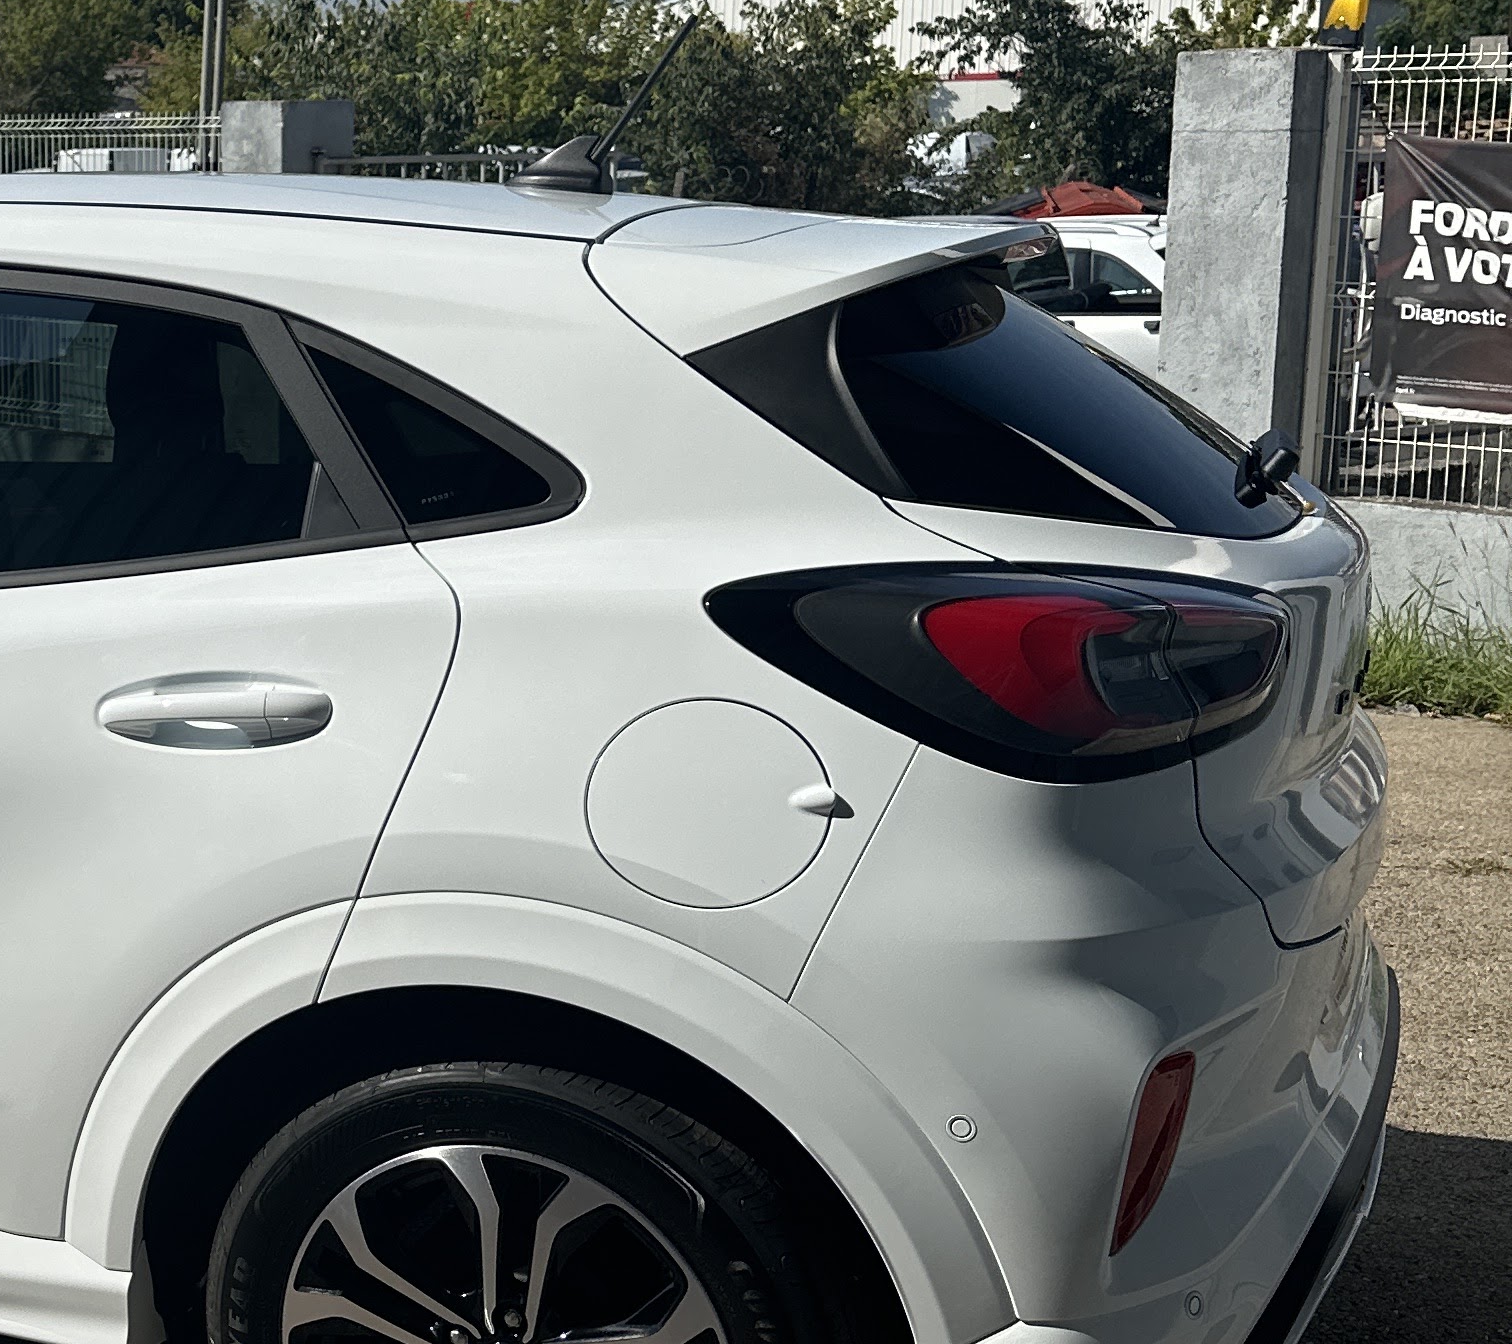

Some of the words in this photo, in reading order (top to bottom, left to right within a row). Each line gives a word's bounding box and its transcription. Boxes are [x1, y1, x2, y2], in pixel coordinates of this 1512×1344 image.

[1409, 200, 1512, 245] FORD
[1403, 235, 1435, 281] À
[1400, 303, 1507, 327] Diagnostic
